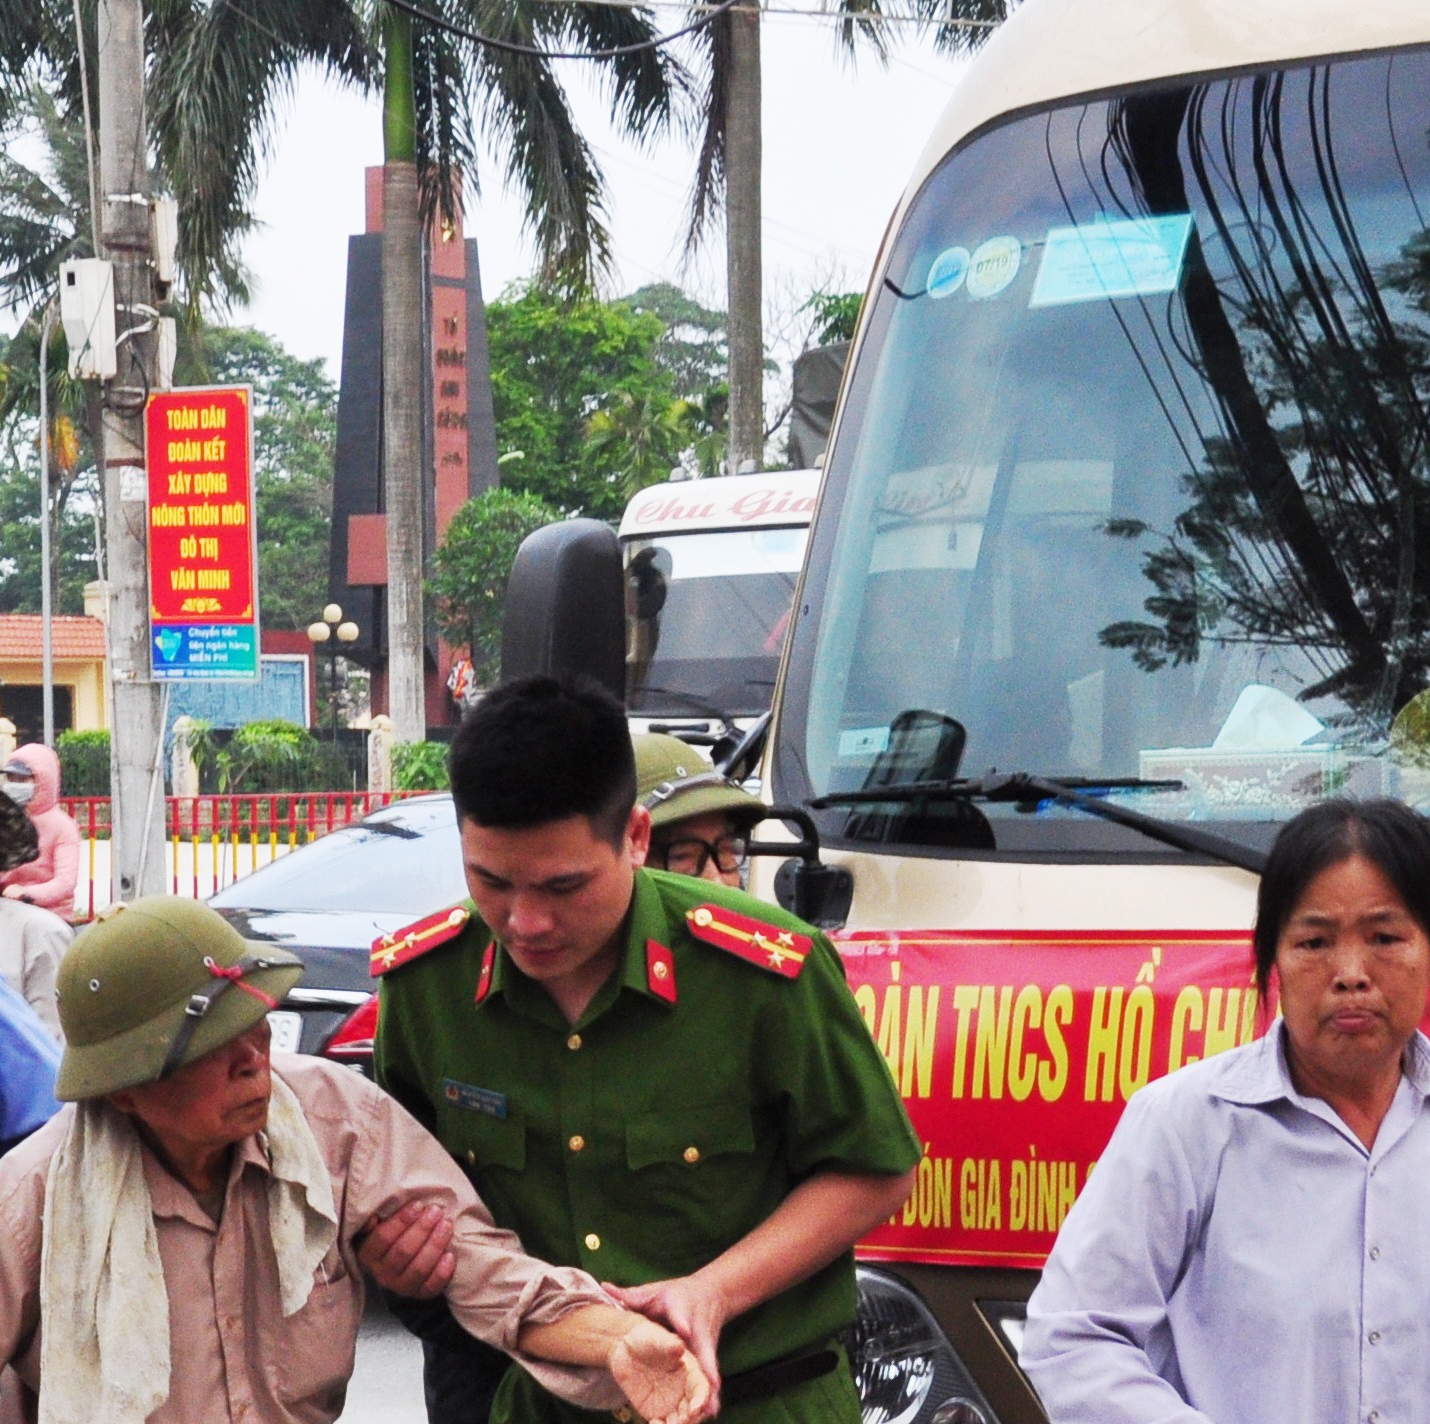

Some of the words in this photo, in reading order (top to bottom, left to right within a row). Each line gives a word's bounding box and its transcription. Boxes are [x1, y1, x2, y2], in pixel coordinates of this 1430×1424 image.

[166, 405, 198, 430] TOÀN
[200, 404, 226, 429] DÂN
[168, 437, 201, 463] ĐOÀN
[203, 434, 226, 462] KẾT
[168, 469, 191, 495] XÂY
[194, 471, 227, 498] DỰNG
[151, 502, 186, 527] NÔNG
[187, 501, 220, 526] THÔN
[221, 500, 246, 526] MỚI
[635, 497, 716, 525] Chu
[179, 533, 197, 559] ĐÔ
[197, 537, 219, 563] THỊ
[170, 566, 196, 591] VĂN
[197, 568, 230, 591] MINH
[952, 983, 1074, 1103] TNCS
[1084, 946, 1163, 1102] HỒ
[959, 1157, 1003, 1231] GIA
[1009, 1143, 1077, 1233] ĐÌNH
